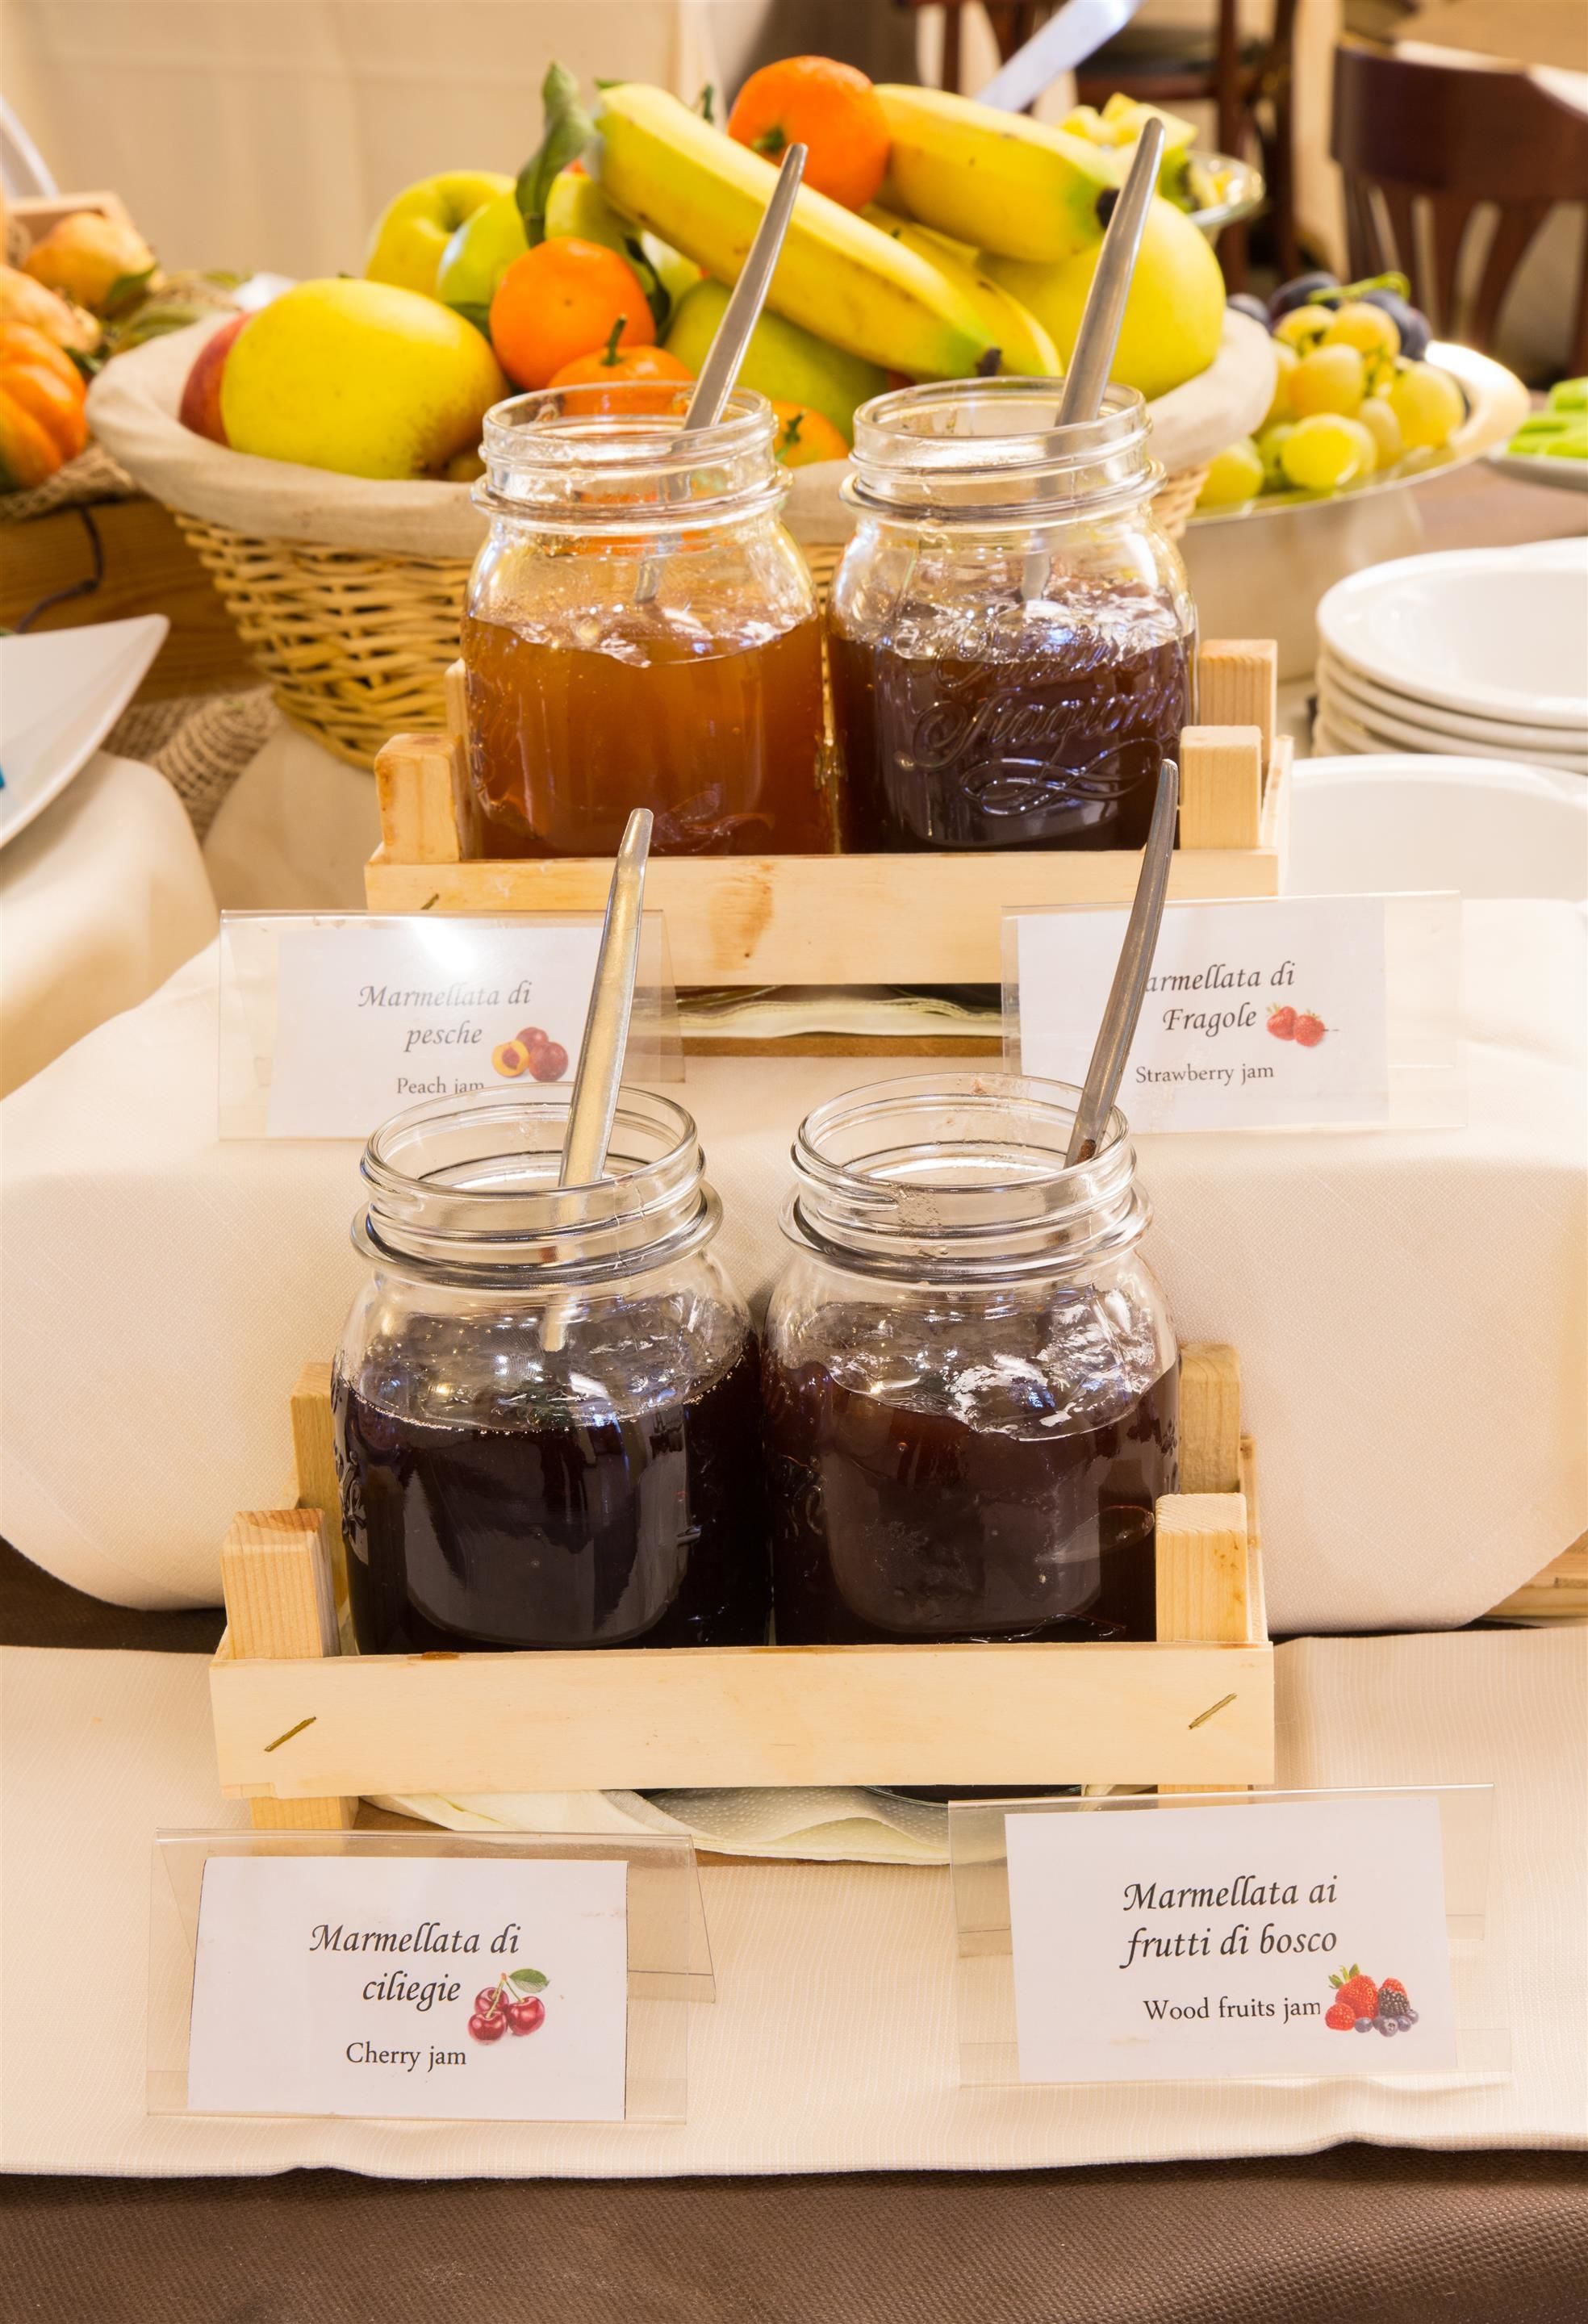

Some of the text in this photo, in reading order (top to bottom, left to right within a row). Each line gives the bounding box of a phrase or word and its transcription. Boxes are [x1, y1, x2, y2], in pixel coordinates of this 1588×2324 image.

[1146, 959, 1296, 993] armellata di
[357, 980, 533, 1007] Marmellata di
[403, 1019, 483, 1053] pesche
[1162, 1001, 1257, 1038] Fragole
[397, 1076, 446, 1094] Peach
[1135, 1063, 1274, 1086] Strawberry jam
[1122, 1875, 1338, 1912] Marmellata ai
[309, 1921, 521, 1954] Marmellata di
[1118, 1922, 1337, 1970] frutti di bosco
[362, 1970, 462, 2013] ciliegie
[1143, 1996, 1321, 2025] Wood fruits jam
[345, 2040, 467, 2073] Cherry jam
